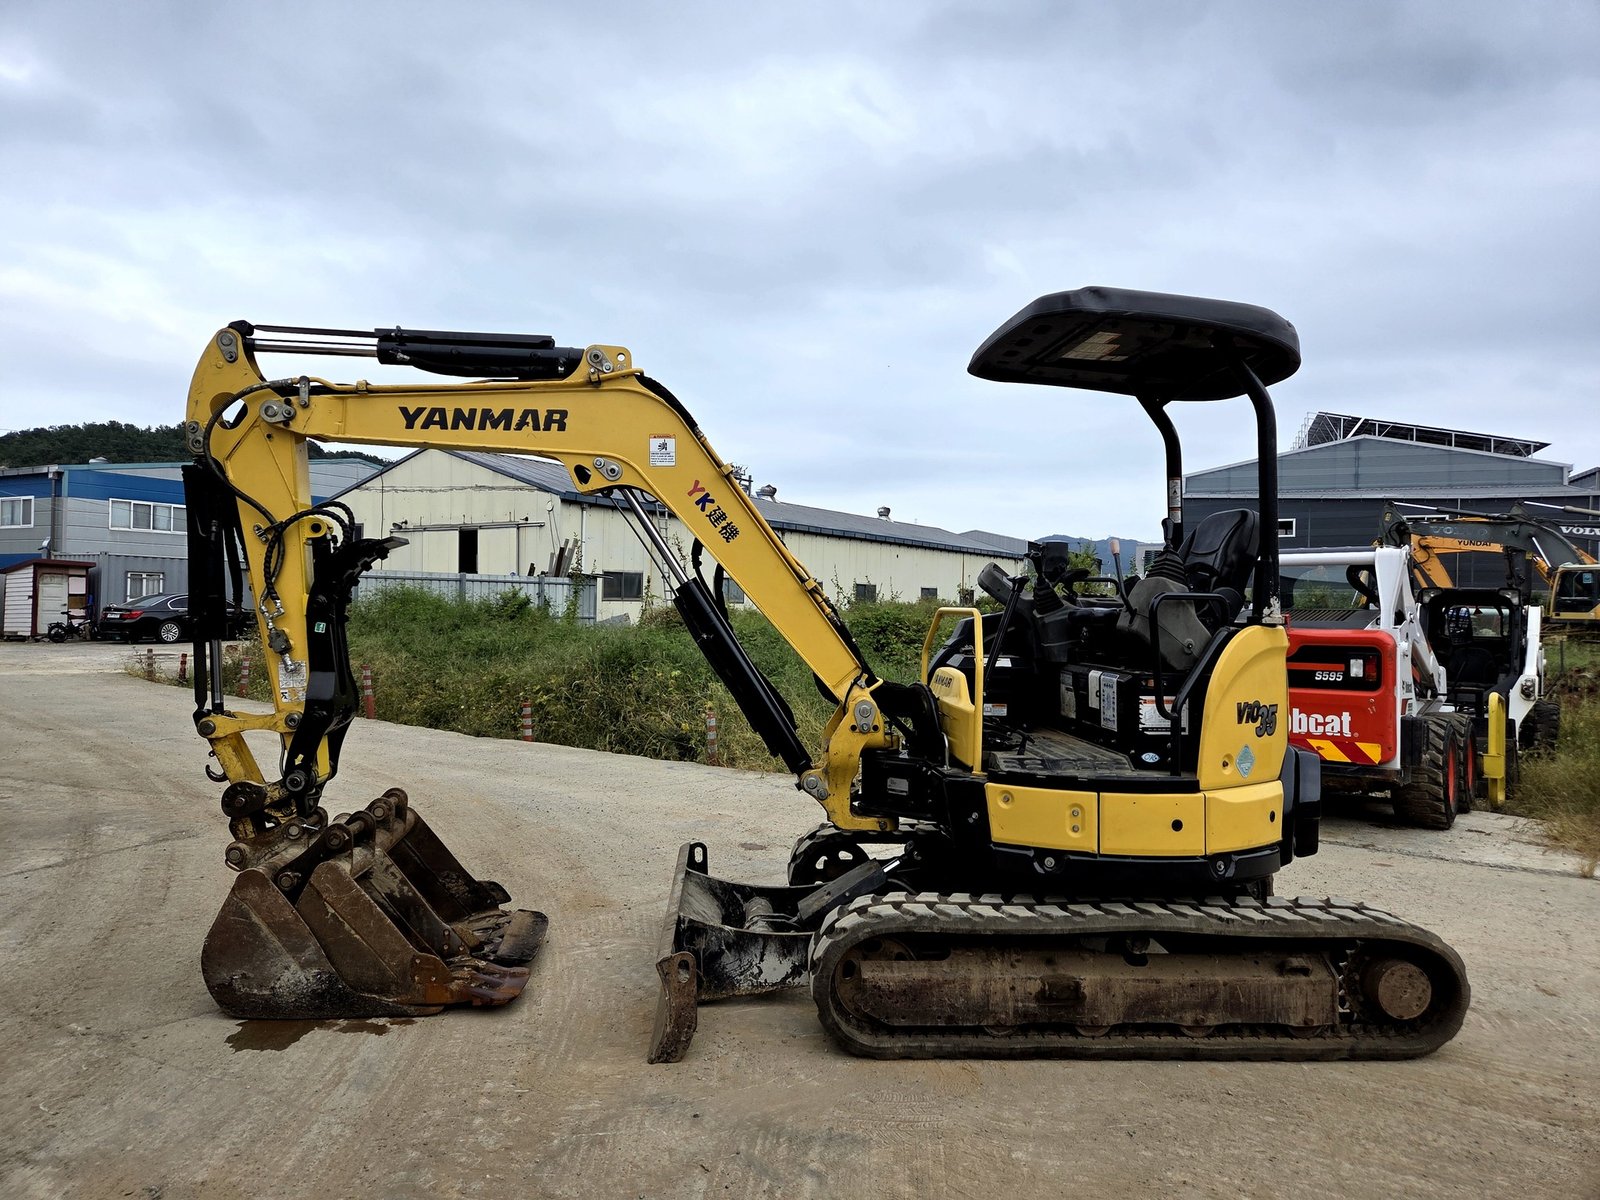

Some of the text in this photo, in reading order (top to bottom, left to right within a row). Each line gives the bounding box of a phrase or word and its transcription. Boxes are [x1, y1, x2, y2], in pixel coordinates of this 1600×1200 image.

[398, 406, 568, 431] YANMAR
[1315, 671, 1343, 681] S595
[1289, 708, 1351, 737] bcat
